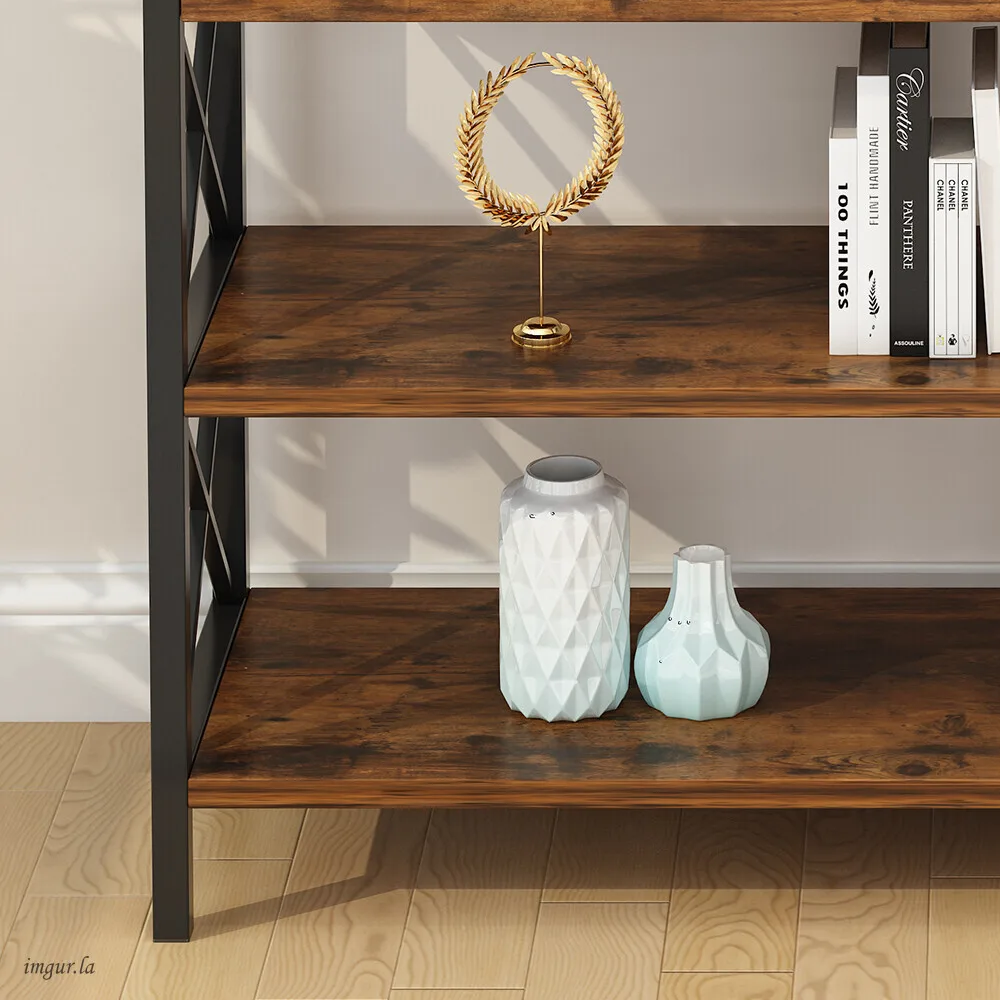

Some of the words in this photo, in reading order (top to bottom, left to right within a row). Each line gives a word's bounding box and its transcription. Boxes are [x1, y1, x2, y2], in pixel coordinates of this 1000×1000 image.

[895, 67, 925, 151] Cartier
[869, 127, 879, 189] HANDMADE
[838, 183, 848, 221] 100
[936, 179, 945, 212] CHANEL
[948, 179, 956, 212] CHANEL
[961, 179, 969, 212] CHANEL
[903, 200, 913, 269] PANTHERE
[838, 229, 848, 309] THINGS
